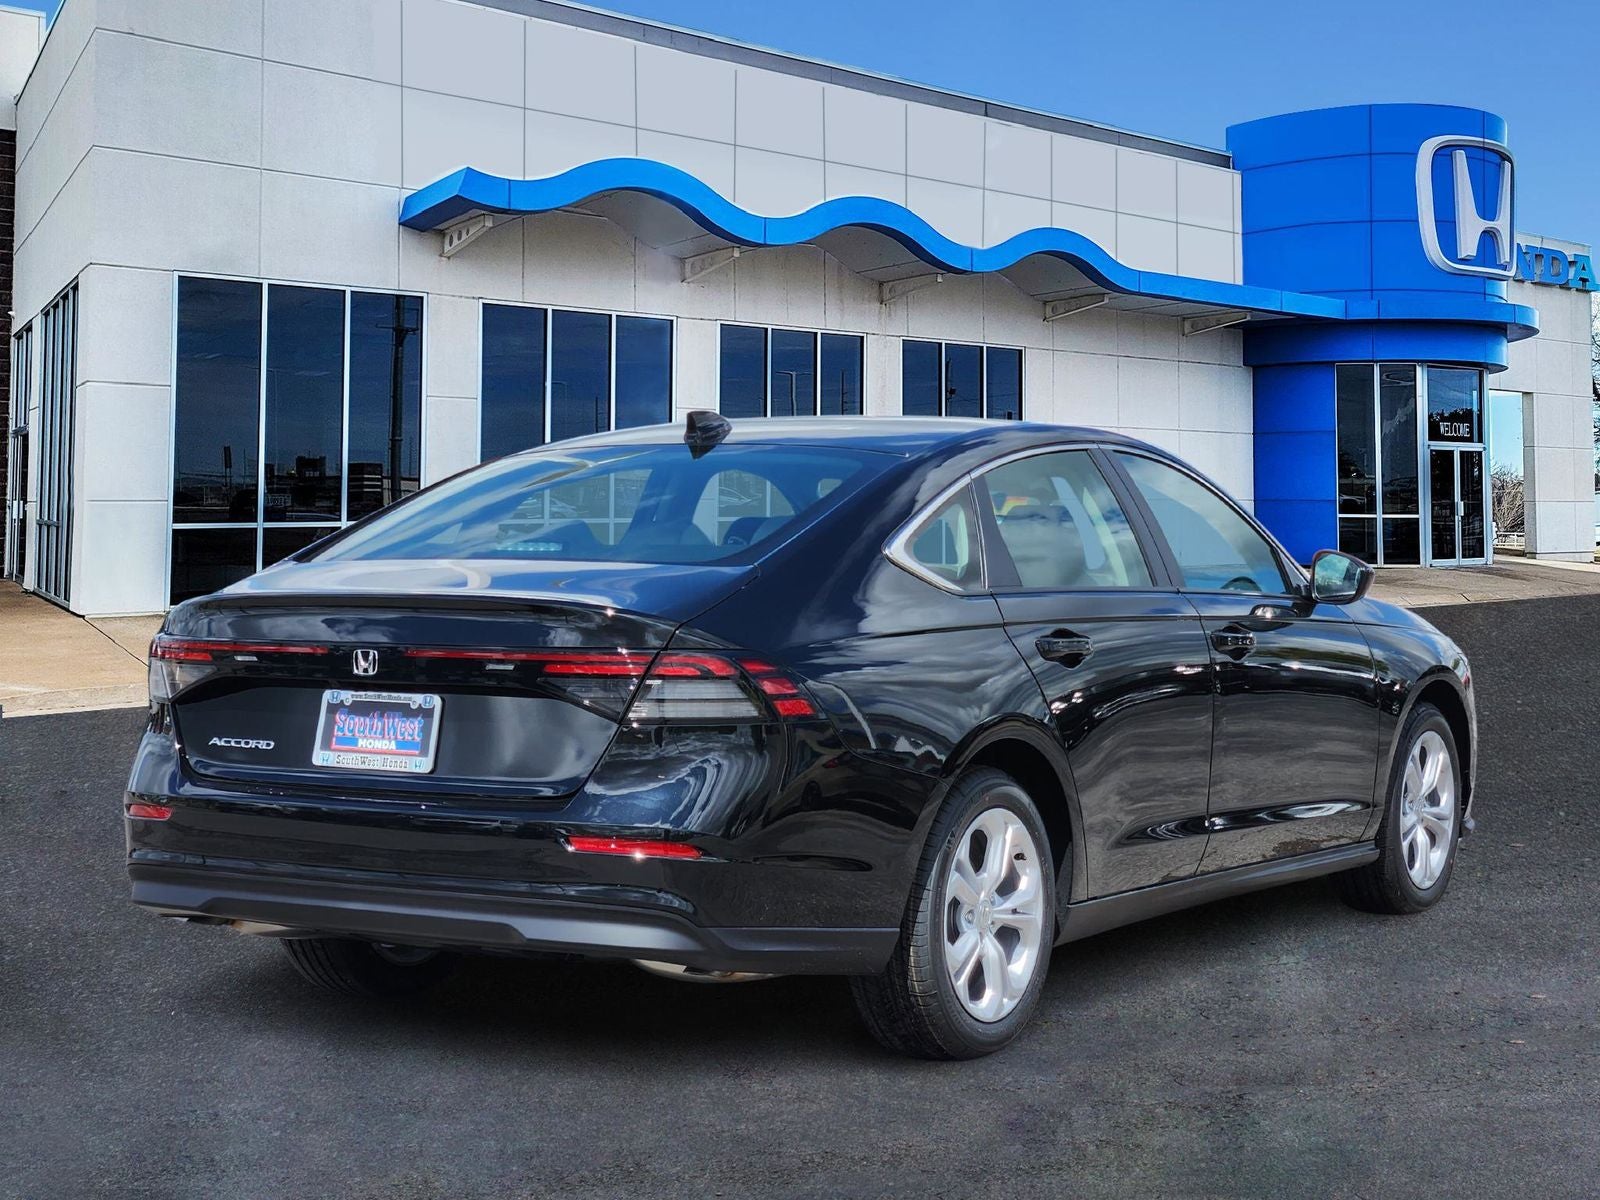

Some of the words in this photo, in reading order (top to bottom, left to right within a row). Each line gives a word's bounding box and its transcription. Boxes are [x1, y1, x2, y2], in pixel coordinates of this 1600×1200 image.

[1514, 243, 1599, 291] NDA
[1440, 422, 1471, 437] WELCOME
[208, 737, 275, 750] ACCORD
[358, 738, 396, 750] HONDA
[336, 754, 379, 767] SouthWest
[382, 757, 408, 769] Honda
